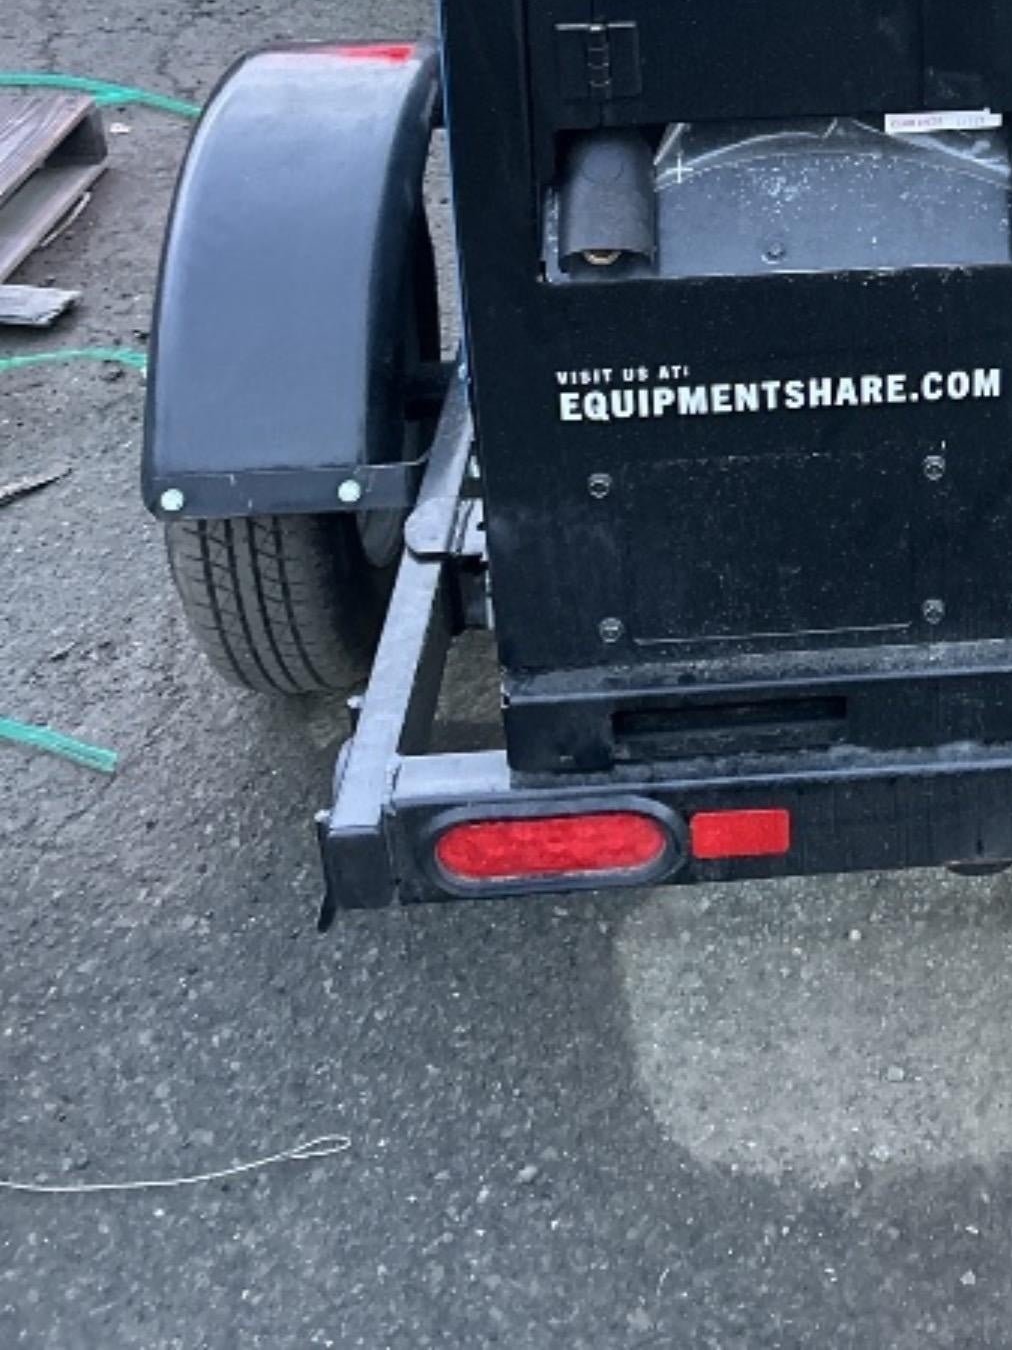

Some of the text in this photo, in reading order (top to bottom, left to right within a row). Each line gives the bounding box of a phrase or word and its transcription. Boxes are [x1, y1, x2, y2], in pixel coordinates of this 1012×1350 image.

[555, 367, 613, 385] VISIT
[622, 367, 649, 382] US
[559, 368, 1002, 422] EQUIPMENTSHARE.COM
